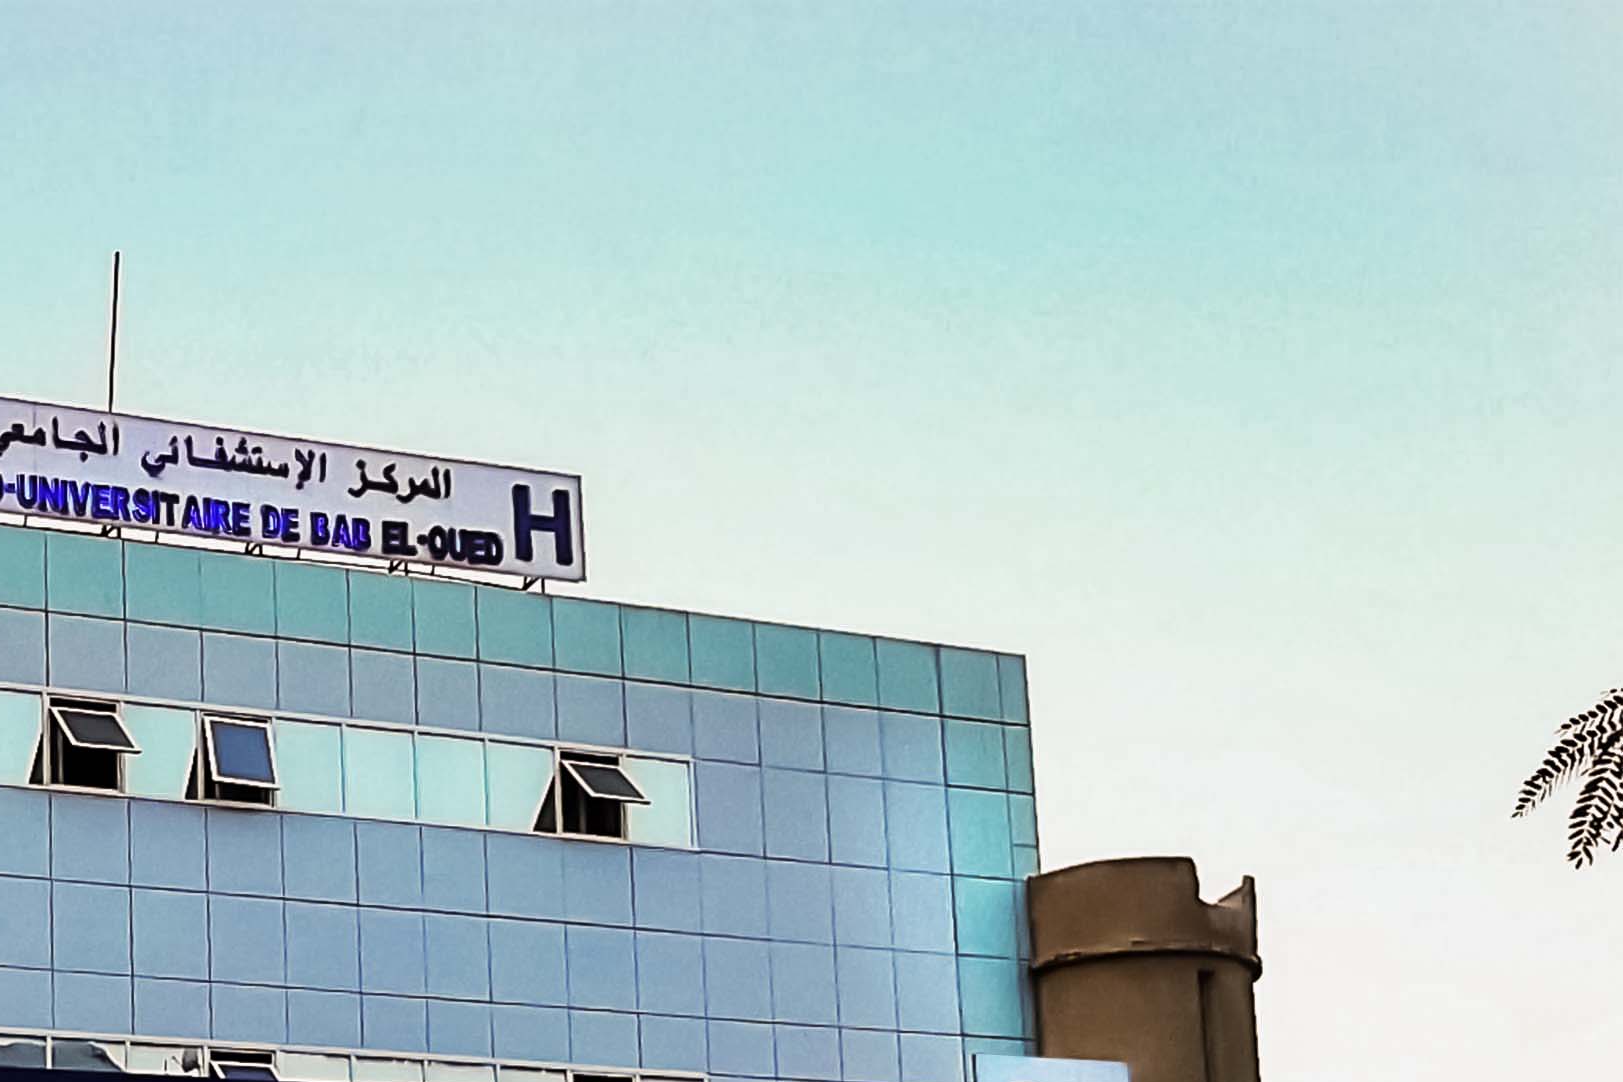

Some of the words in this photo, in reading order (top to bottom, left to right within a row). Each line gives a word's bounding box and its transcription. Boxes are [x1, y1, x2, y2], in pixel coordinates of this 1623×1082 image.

[348, 459, 451, 503] المركز
[259, 504, 301, 543] DE
[309, 511, 372, 550] BAB
[380, 520, 504, 567] EL-OUED
[511, 484, 576, 566] H
